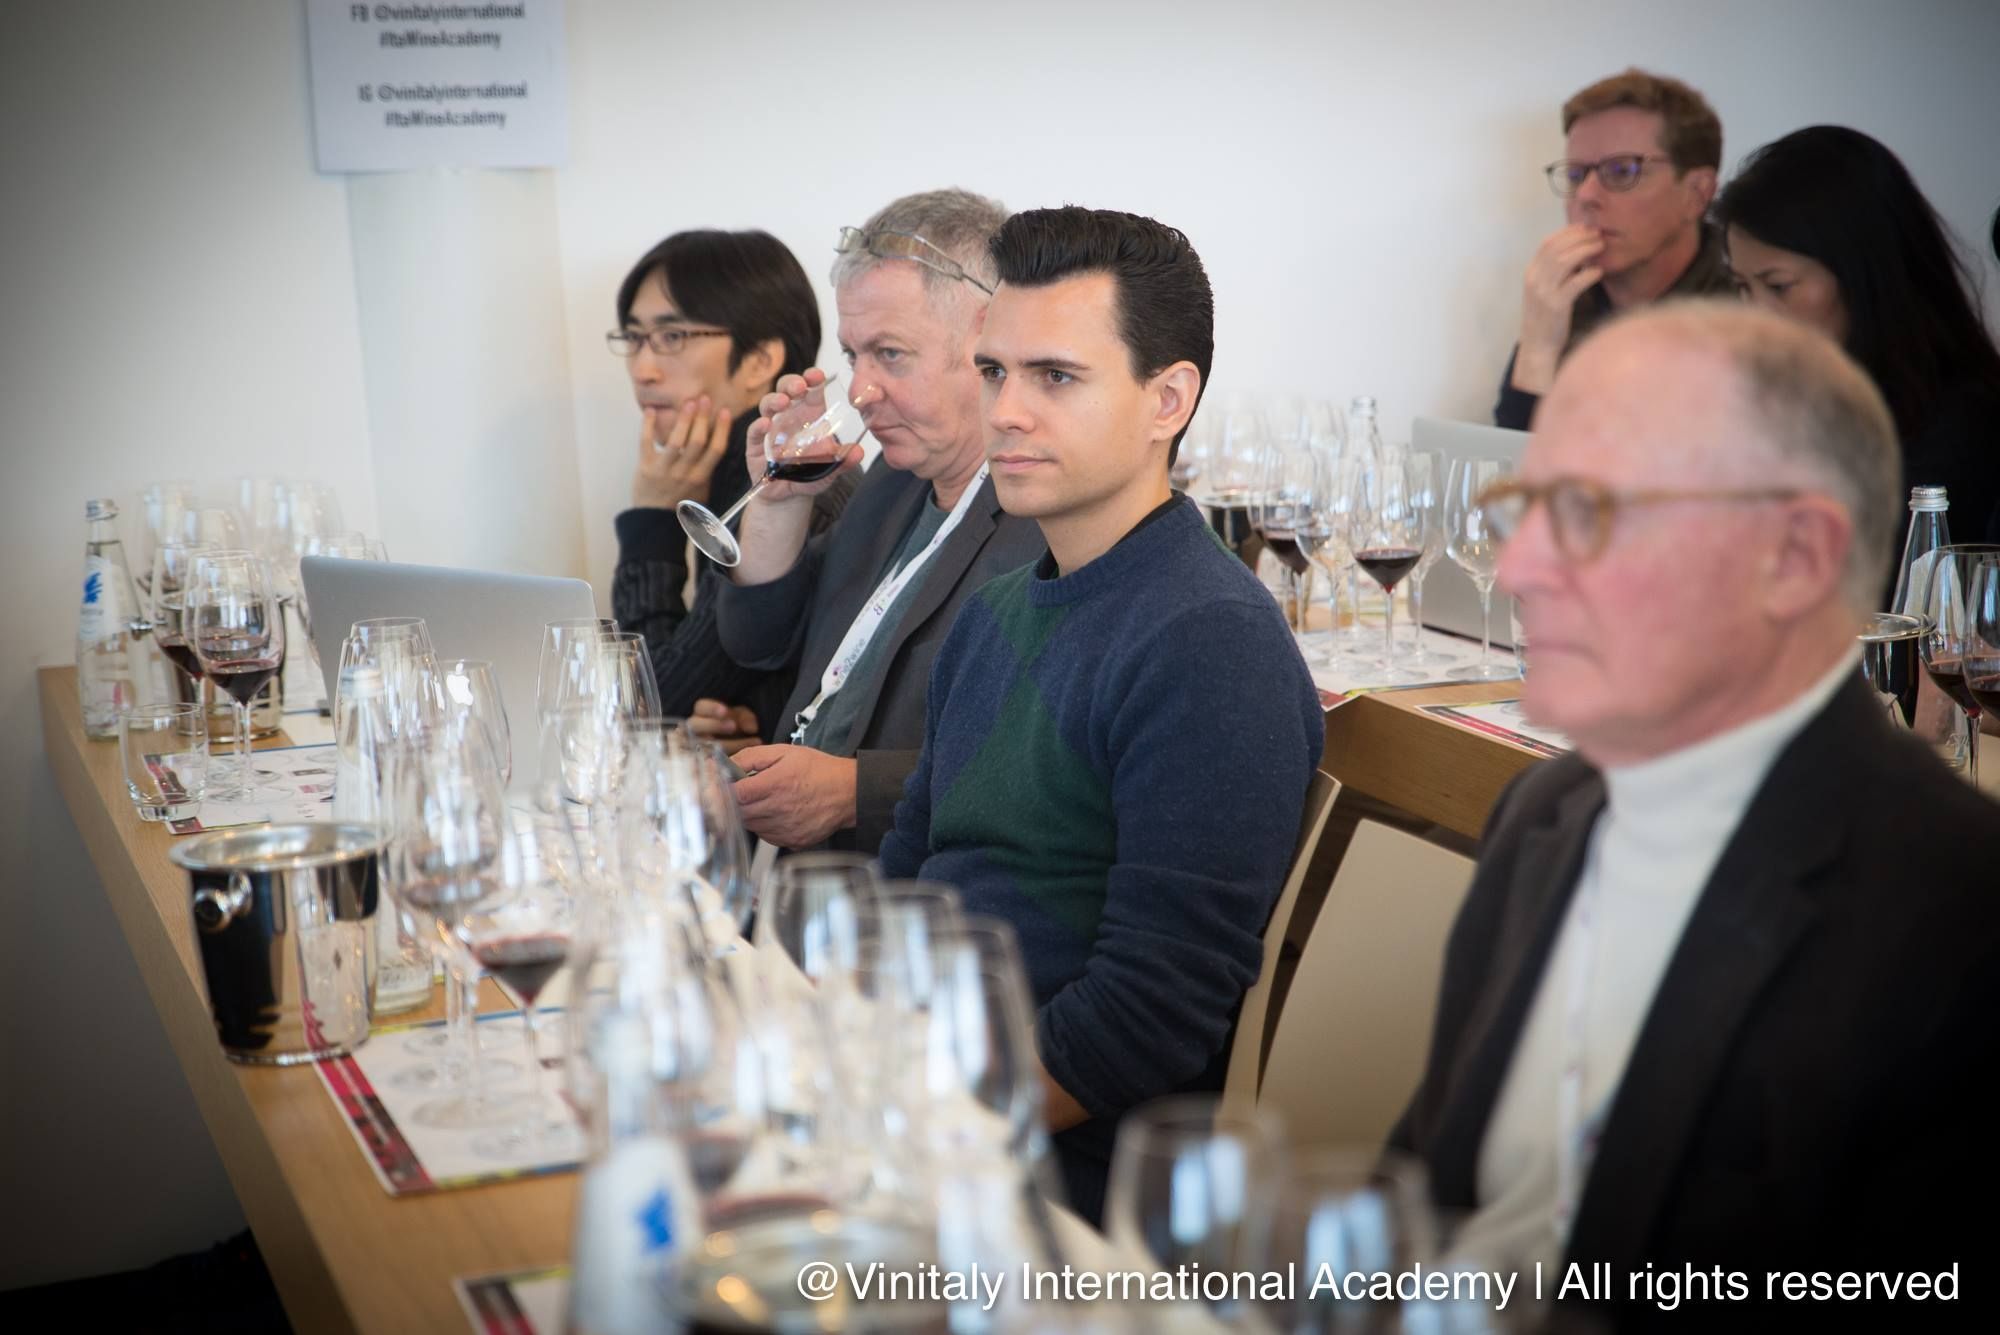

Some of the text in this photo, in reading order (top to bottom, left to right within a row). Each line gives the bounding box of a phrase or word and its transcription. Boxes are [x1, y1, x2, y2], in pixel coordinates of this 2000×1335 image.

[350, 2, 525, 24] FB @vinitalyinternational
[379, 29, 502, 50] #ItaWineAcademy
[377, 80, 528, 104] @vinitalyinternational
[384, 109, 507, 130] #ItaWineAcademy
